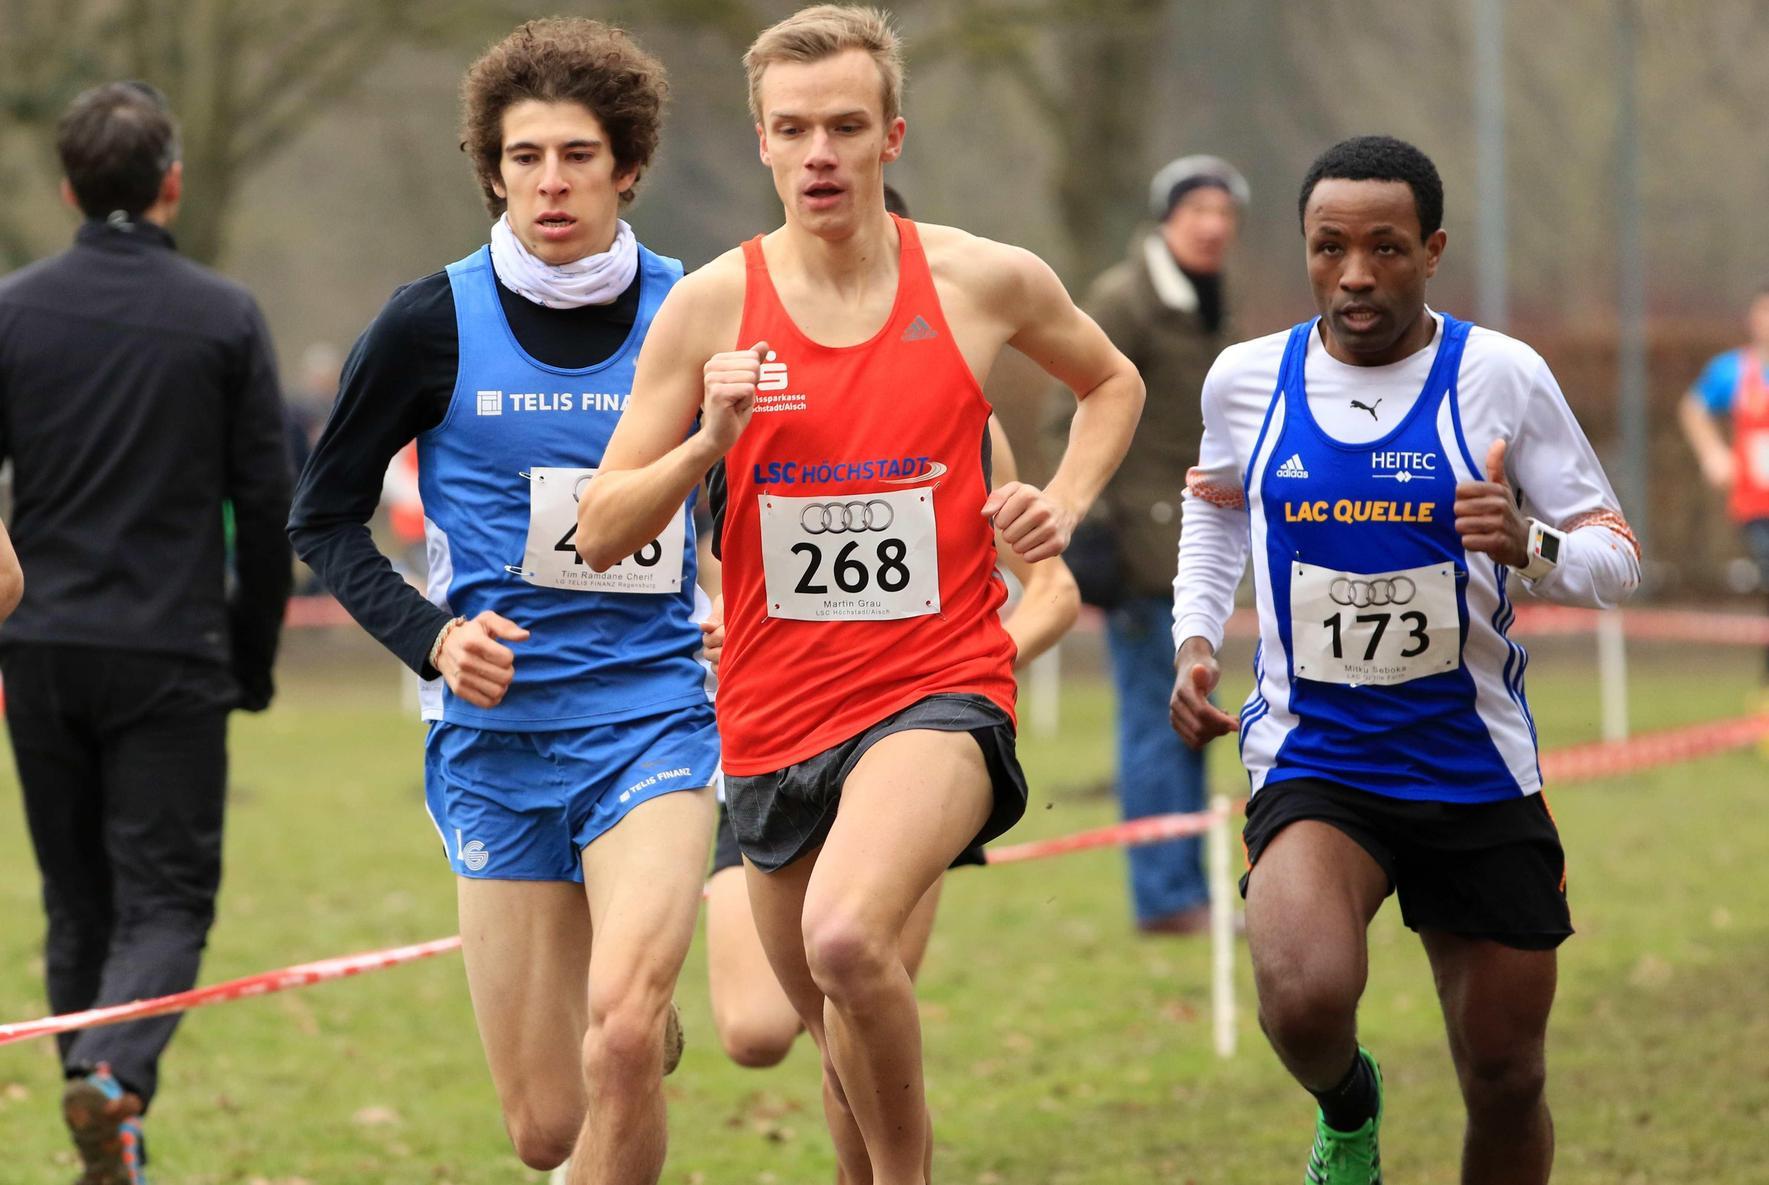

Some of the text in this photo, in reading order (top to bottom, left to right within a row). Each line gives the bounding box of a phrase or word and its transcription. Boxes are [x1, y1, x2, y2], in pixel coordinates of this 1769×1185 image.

[509, 392, 573, 412] TELIS
[754, 456, 930, 485] LSC HÖCHSTADT
[1371, 451, 1437, 471] HEITEC
[1276, 469, 1309, 479] adidas
[1284, 499, 1436, 524] LAC QUELLE
[561, 570, 653, 581] Tim Ramdane Cherif
[790, 537, 911, 594] 268
[590, 580, 616, 588] FINANZ
[823, 599, 881, 608] Martin Grau
[1322, 611, 1431, 661] 173
[1344, 664, 1369, 674] Mitku
[629, 767, 692, 793] TELIS FINANZ
